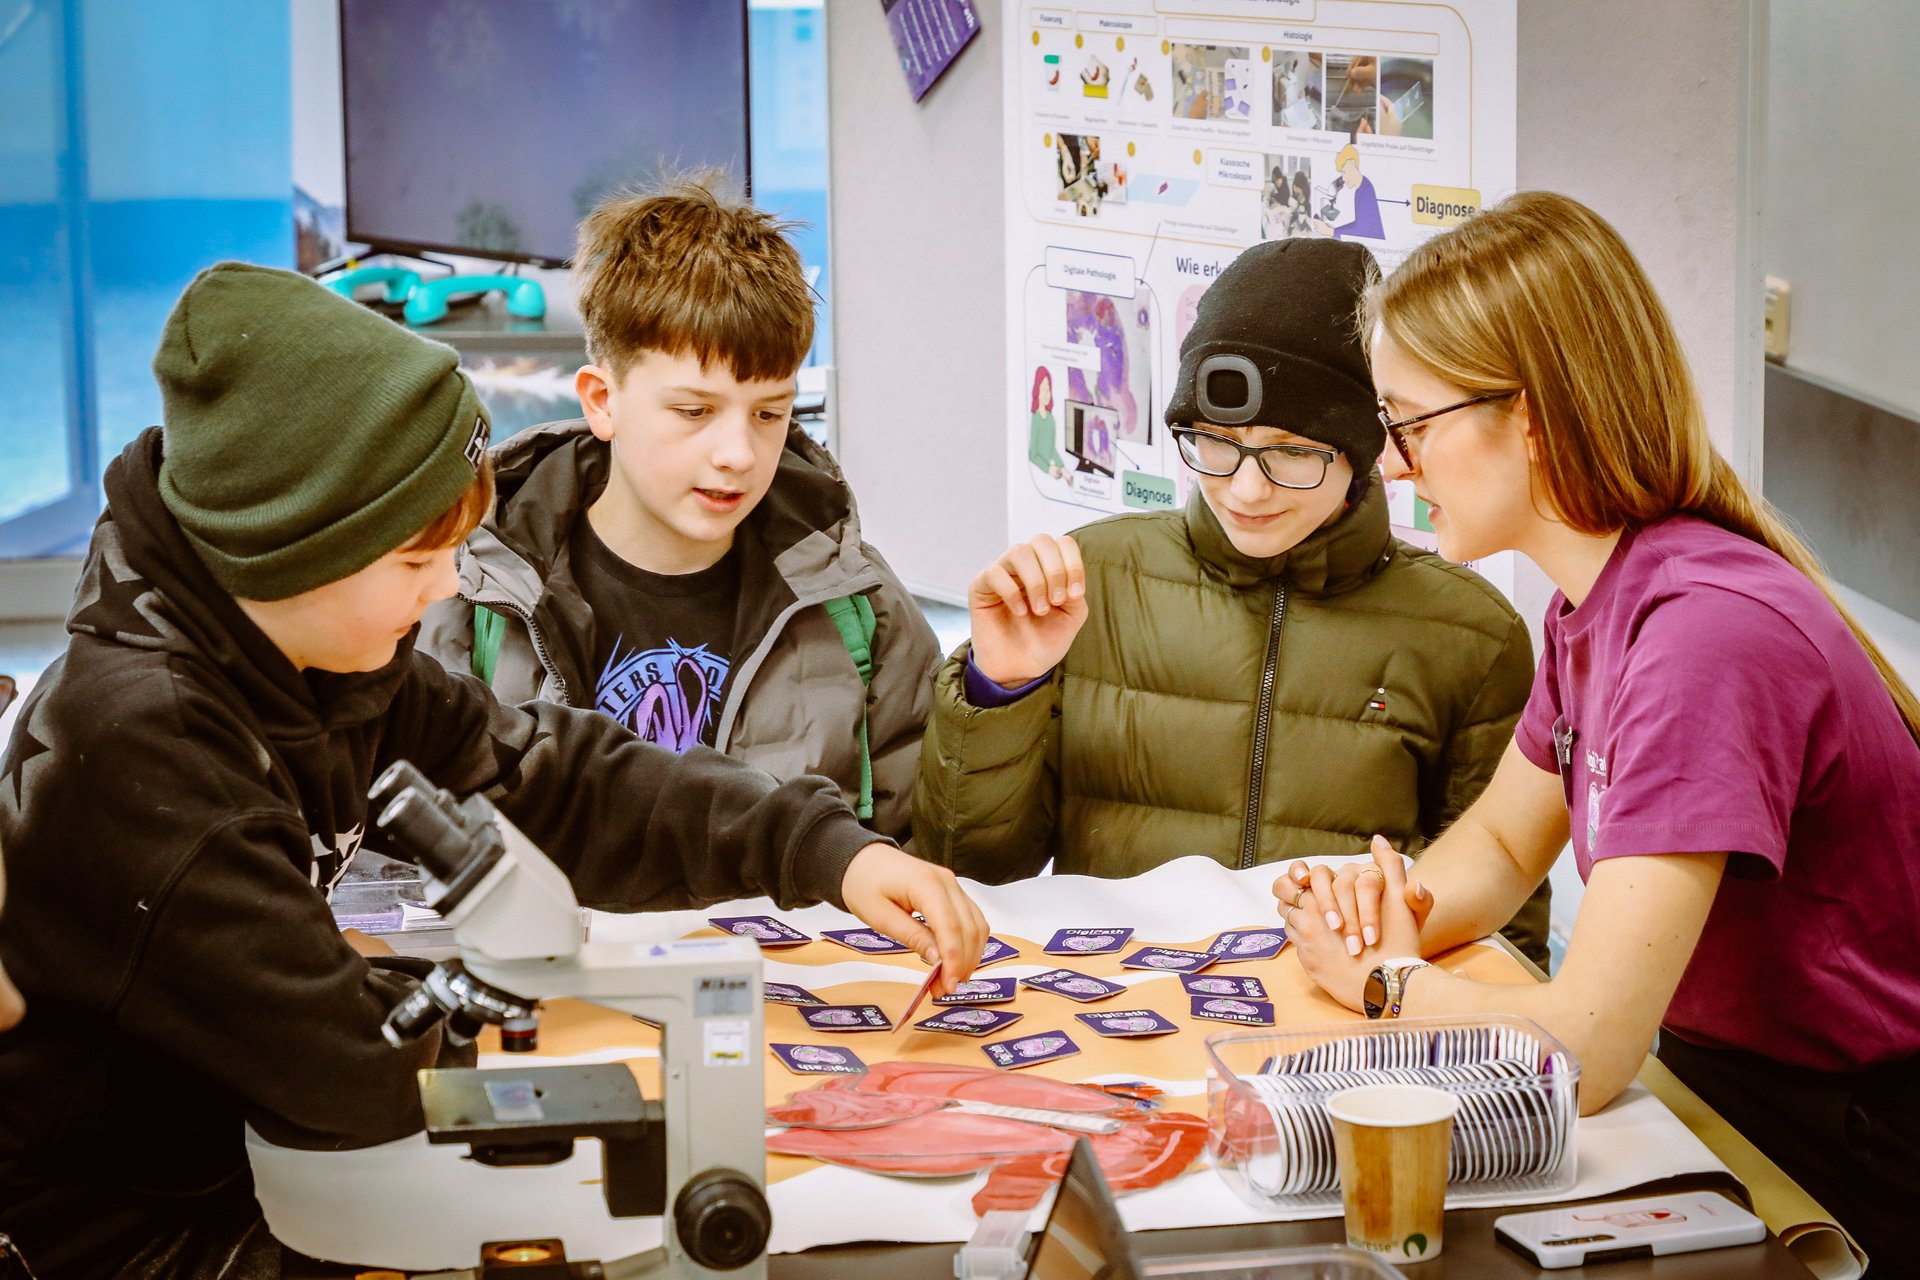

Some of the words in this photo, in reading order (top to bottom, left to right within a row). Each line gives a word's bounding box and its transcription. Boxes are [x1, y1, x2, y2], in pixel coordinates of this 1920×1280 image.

[1283, 31, 1313, 41] Histologie
[1219, 158, 1251, 168] Klassische
[1218, 170, 1253, 181] Mikroskopie
[1416, 196, 1476, 220] Diagnose
[1176, 256, 1200, 275] Wie
[1126, 481, 1173, 505] Diagnose
[1151, 948, 1209, 959] DigiPath
[700, 979, 748, 992] Nikon
[1086, 1010, 1150, 1019] DigiPath
[1199, 1011, 1264, 1022] DigiPath
